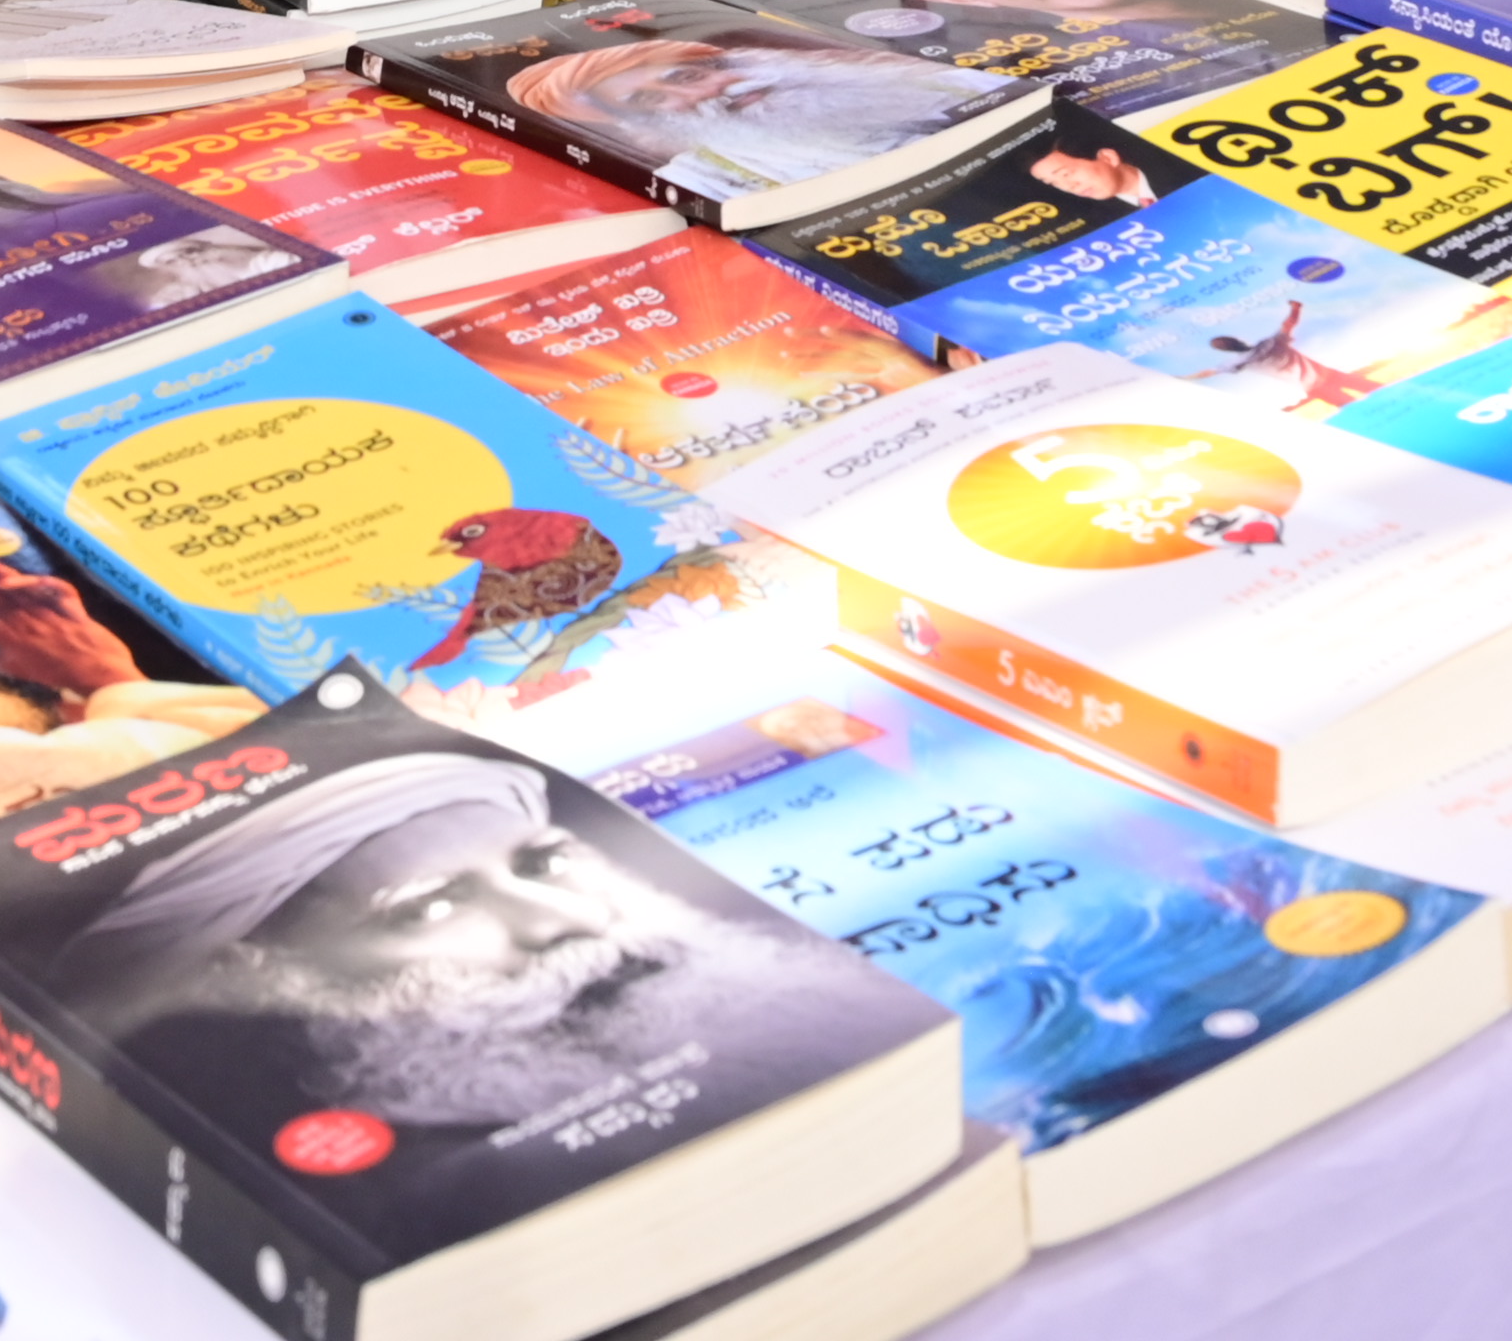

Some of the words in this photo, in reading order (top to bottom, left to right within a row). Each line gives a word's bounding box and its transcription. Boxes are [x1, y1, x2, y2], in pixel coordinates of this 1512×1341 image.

[326, 197, 348, 214] IS
[348, 169, 461, 207] EVERYTHING
[1022, 235, 1253, 334] ನಿಯಮಗಳು
[569, 363, 624, 403] Law
[659, 308, 793, 370] Attraction
[102, 476, 182, 515] 100
[235, 526, 327, 570] INSPIRING
[330, 500, 406, 539] STORIES
